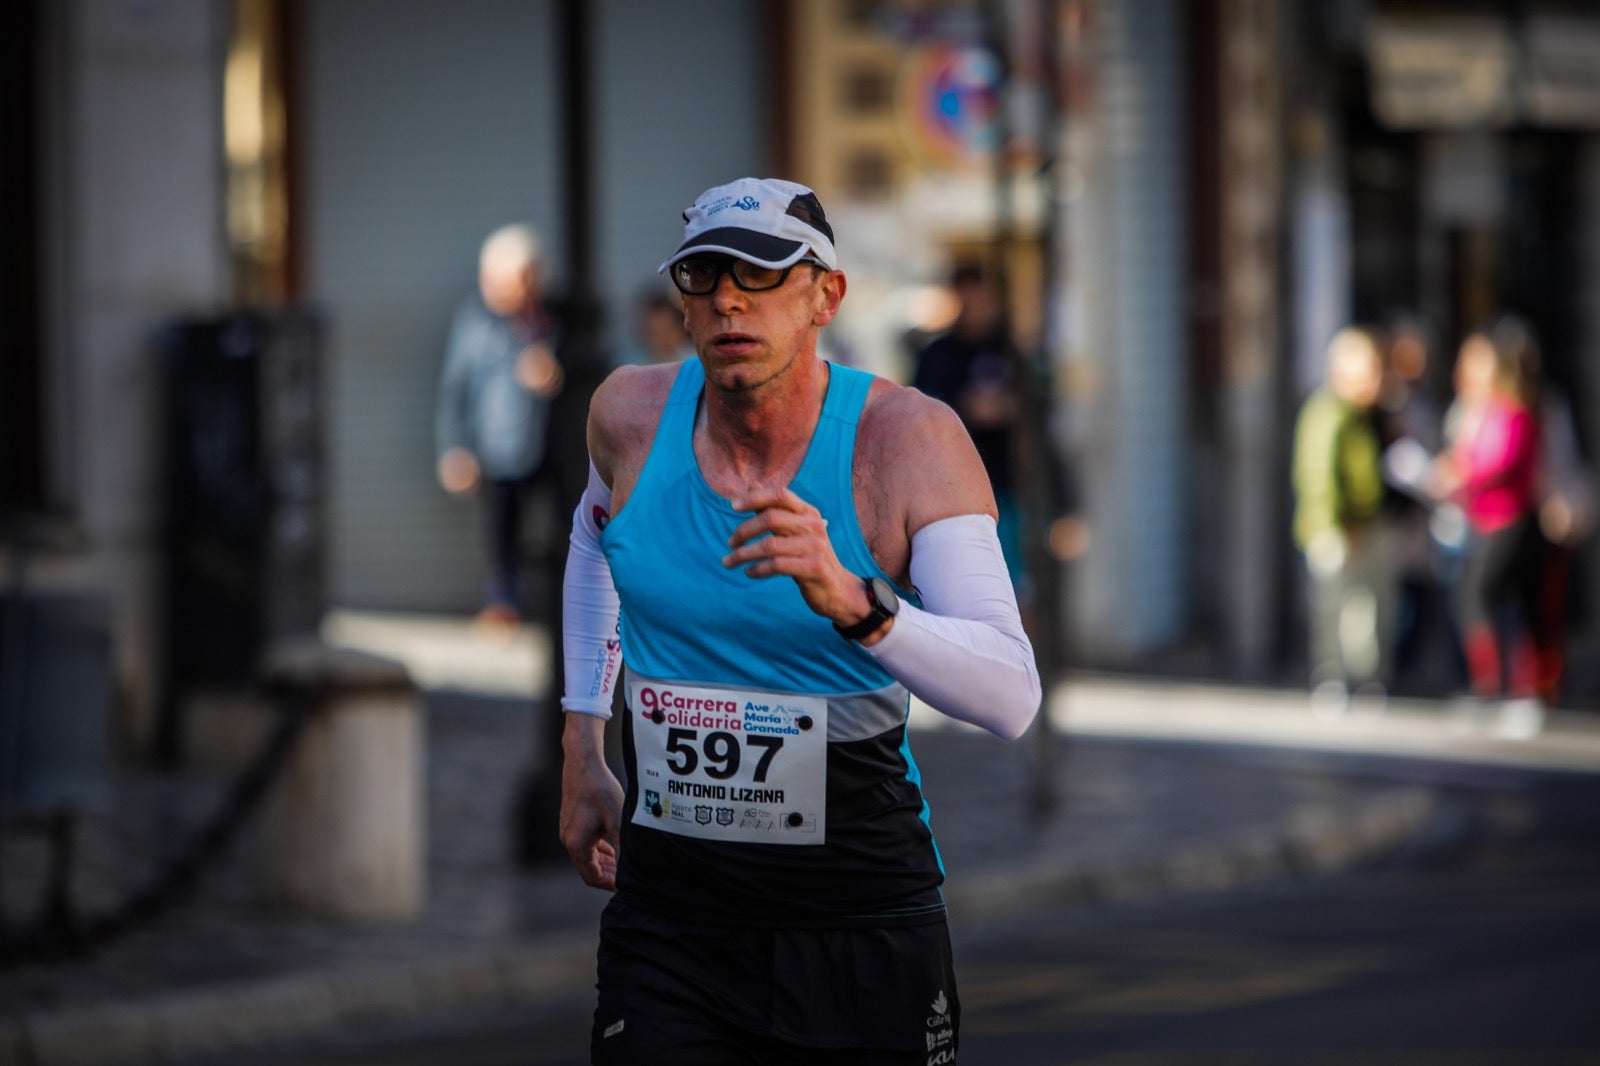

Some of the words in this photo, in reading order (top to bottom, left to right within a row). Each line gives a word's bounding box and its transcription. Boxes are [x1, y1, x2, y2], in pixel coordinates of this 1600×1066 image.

[661, 691, 737, 714] Carrera
[744, 702, 769, 713] Ave
[744, 712, 781, 724] María
[743, 722, 800, 736] Granada
[665, 727, 784, 783] 597
[668, 779, 726, 800] ANTONIO
[730, 786, 785, 804] LIZANA
